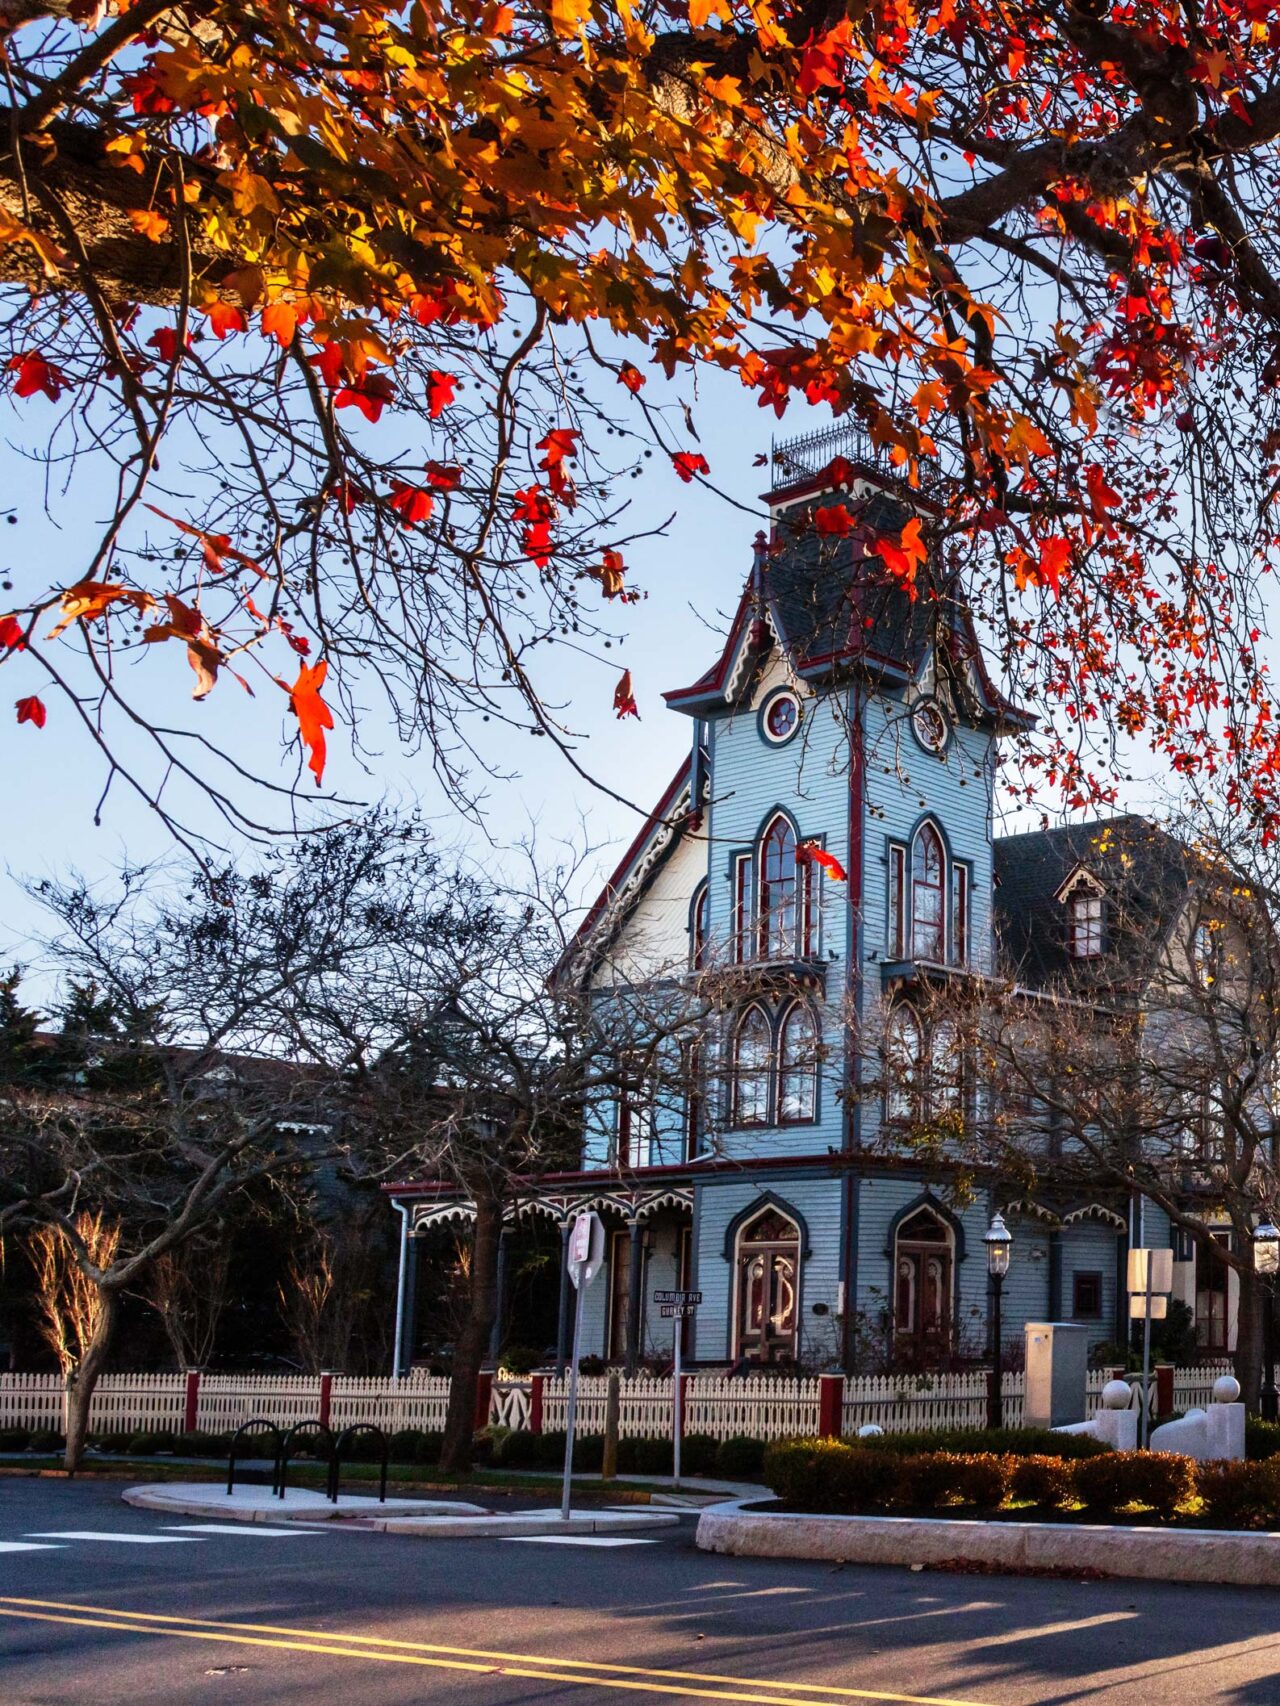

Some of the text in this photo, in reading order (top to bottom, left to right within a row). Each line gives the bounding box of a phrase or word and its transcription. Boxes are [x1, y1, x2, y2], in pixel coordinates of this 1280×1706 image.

[654, 1292, 701, 1302] COLUMBIA AVE
[687, 1305, 694, 1315] ST
